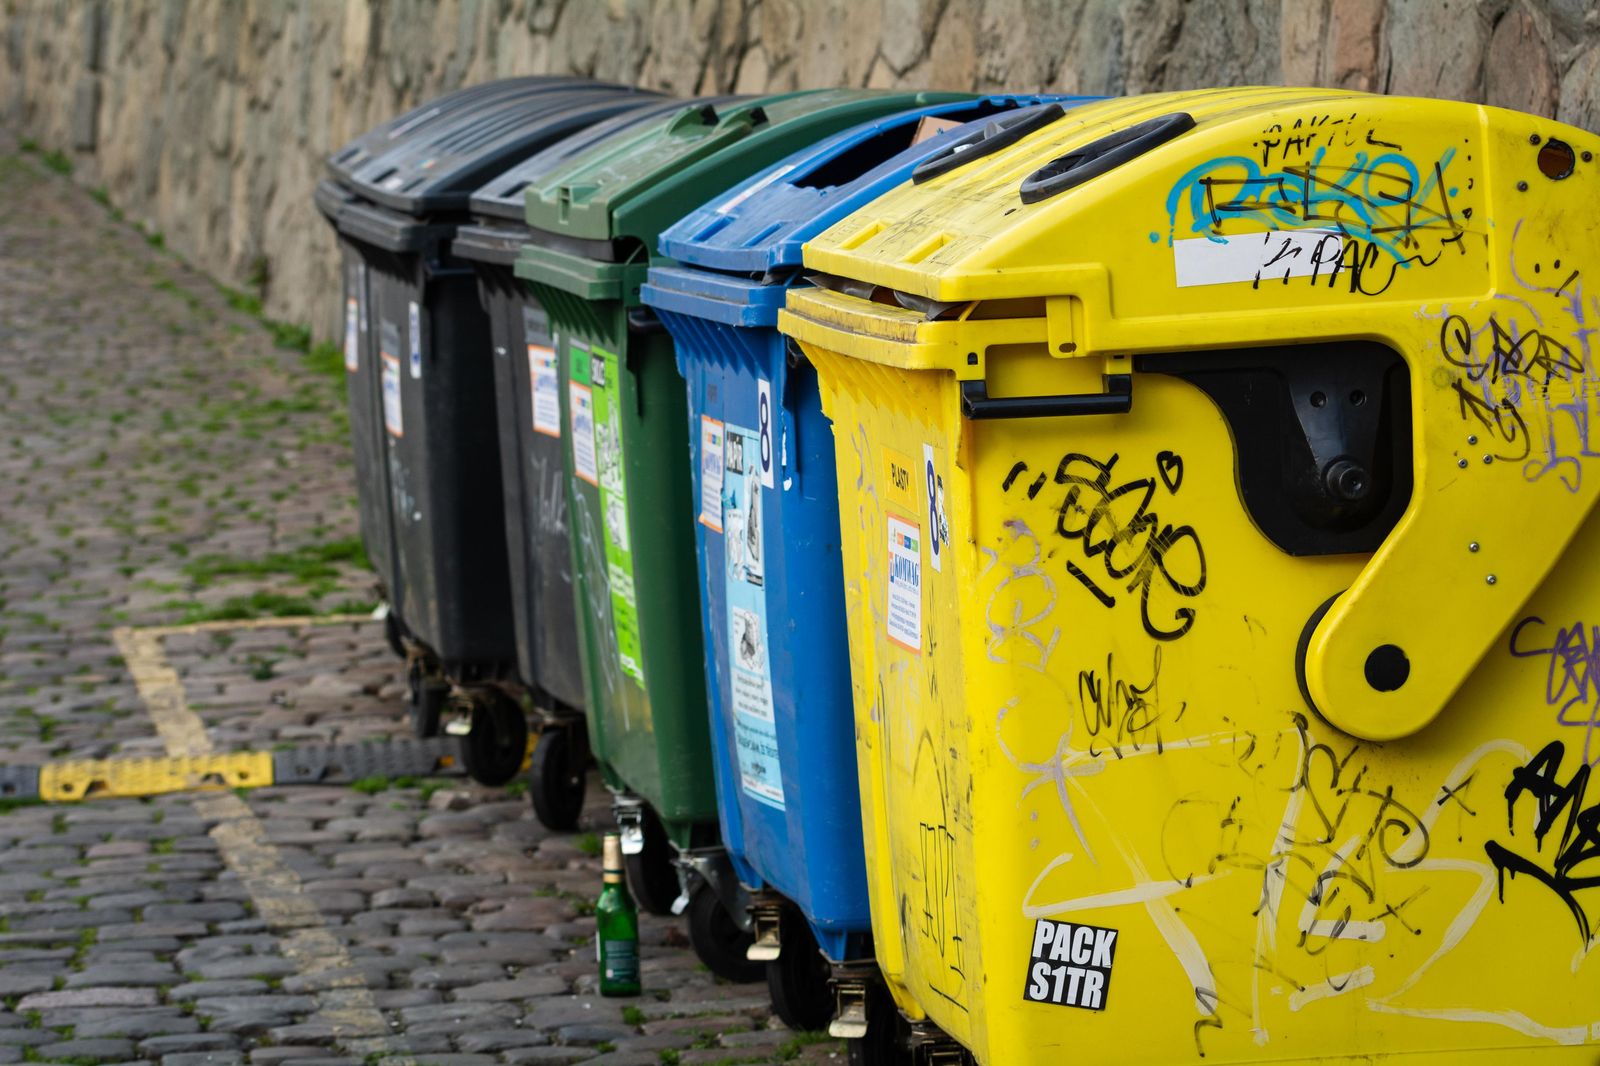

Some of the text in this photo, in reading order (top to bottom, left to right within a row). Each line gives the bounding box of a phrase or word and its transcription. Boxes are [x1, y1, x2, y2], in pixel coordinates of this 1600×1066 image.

[760, 391, 771, 474] 8
[890, 462, 910, 494] PLASTY
[926, 459, 940, 556] 8
[1031, 919, 1117, 969] PACK
[1029, 961, 1105, 1009] S1TR
